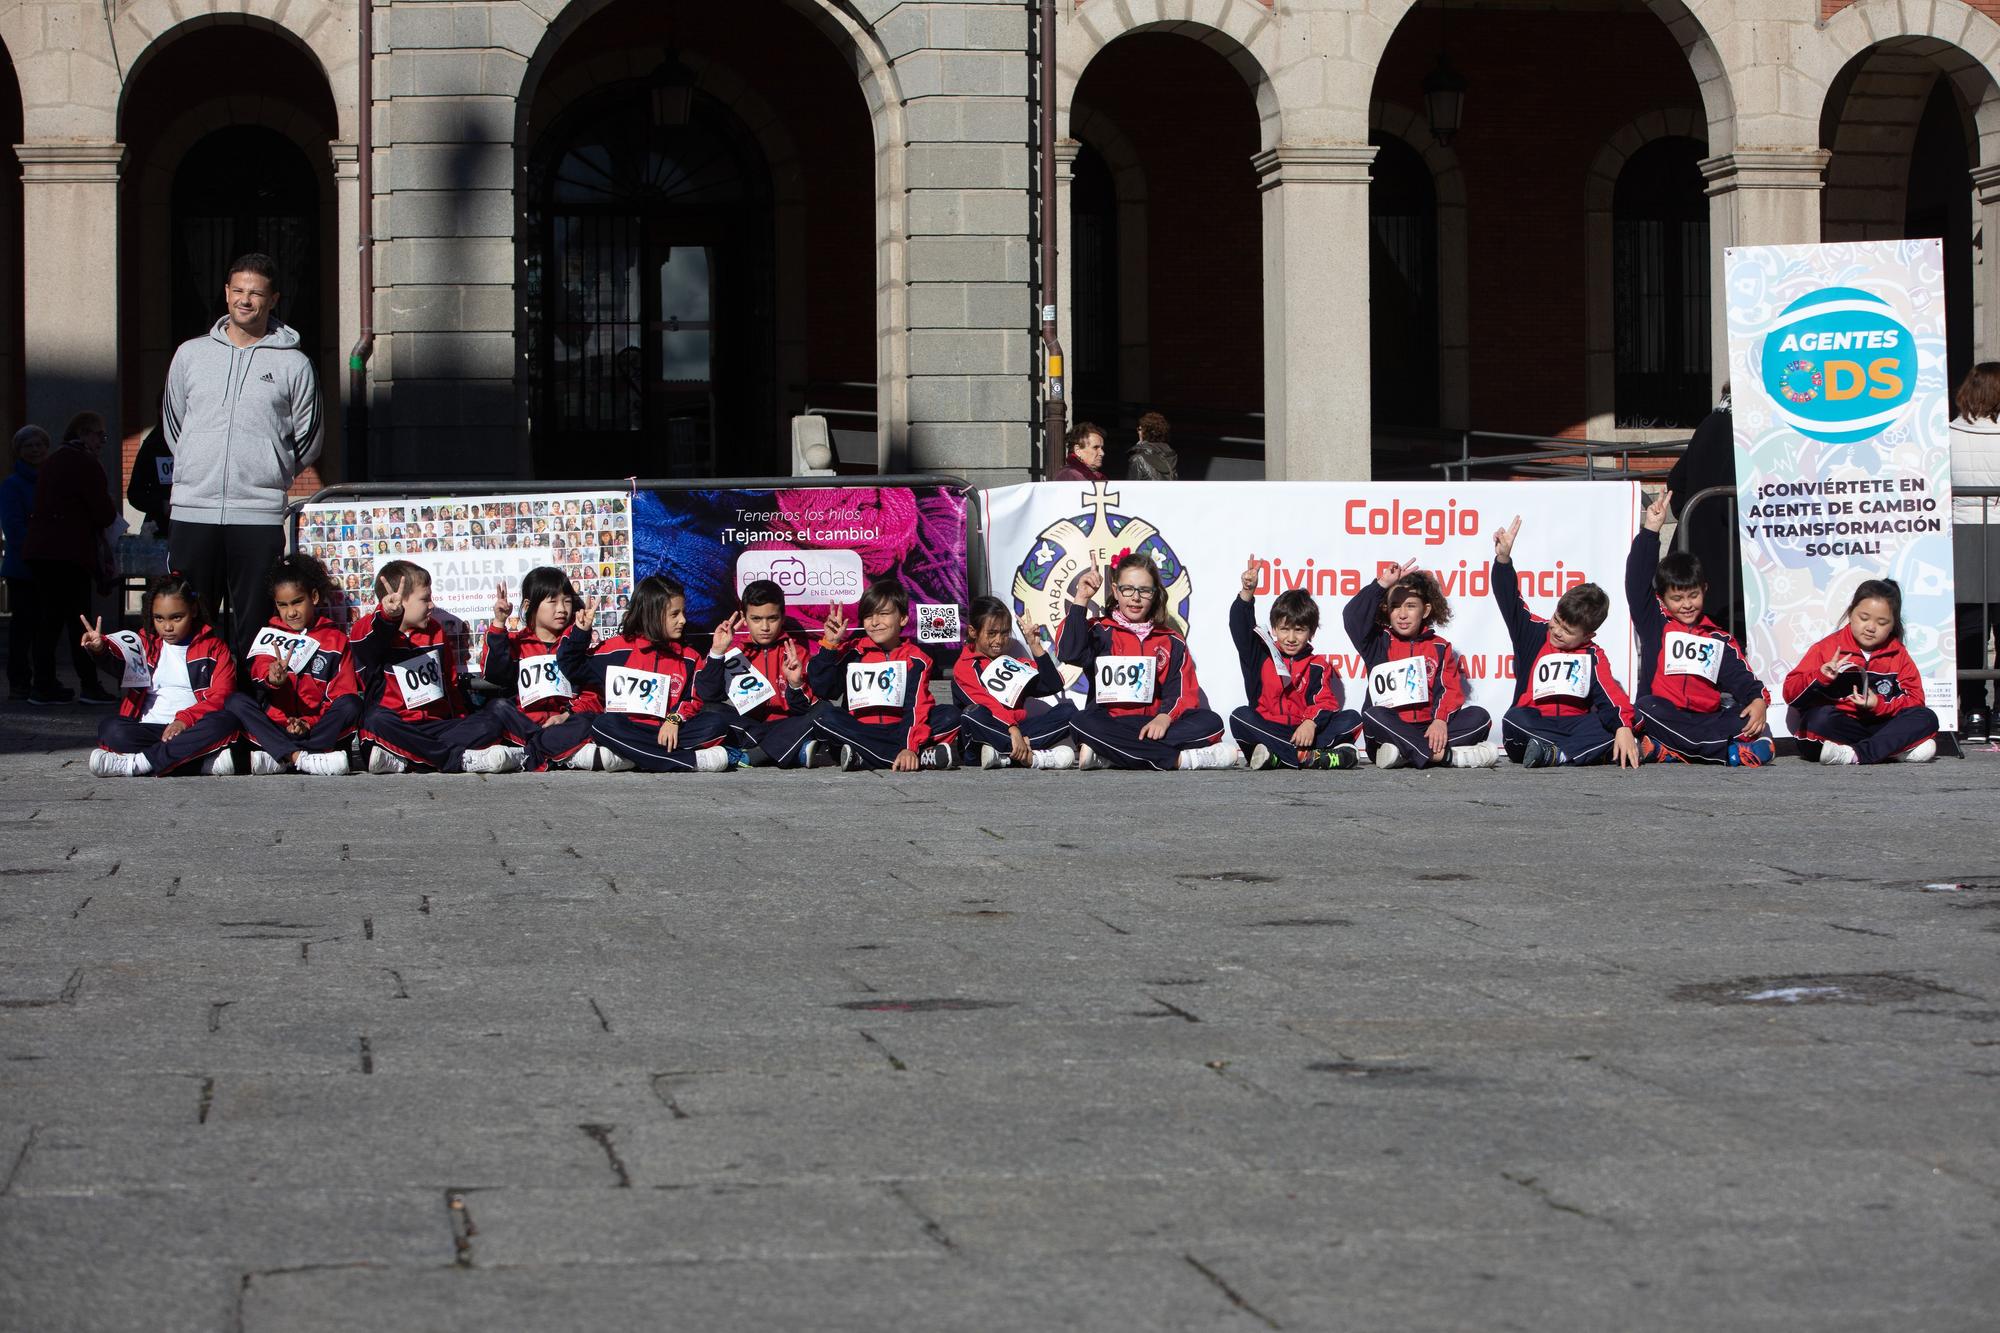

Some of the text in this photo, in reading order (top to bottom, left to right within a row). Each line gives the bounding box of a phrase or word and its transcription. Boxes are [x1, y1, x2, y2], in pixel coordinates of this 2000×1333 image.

[1779, 329, 1900, 353] AGENTES
[1758, 478, 1925, 500] ¡CONVIÉRTETE EN
[736, 508, 864, 522] Tenemos los hilos,
[1749, 498, 1937, 519] AGENTE DE CAMBIO
[1345, 498, 1479, 545] Colegio
[1746, 516, 1941, 539] Y TRANSFORMACIÓN
[721, 527, 879, 545] ¡Tejamos el cambio!
[1805, 541, 1881, 557] SOCIAL!
[433, 560, 504, 576] TALLER
[1248, 558, 1361, 596] Divina
[448, 593, 484, 602] tejiendo
[1672, 639, 1709, 662] 065
[405, 661, 439, 690] 068
[520, 662, 557, 689] 078
[723, 658, 758, 690] 070
[851, 669, 890, 692] 076
[987, 659, 1021, 692] 066
[1101, 665, 1140, 687] 069
[1538, 661, 1575, 682] 077
[613, 675, 652, 698] 079
